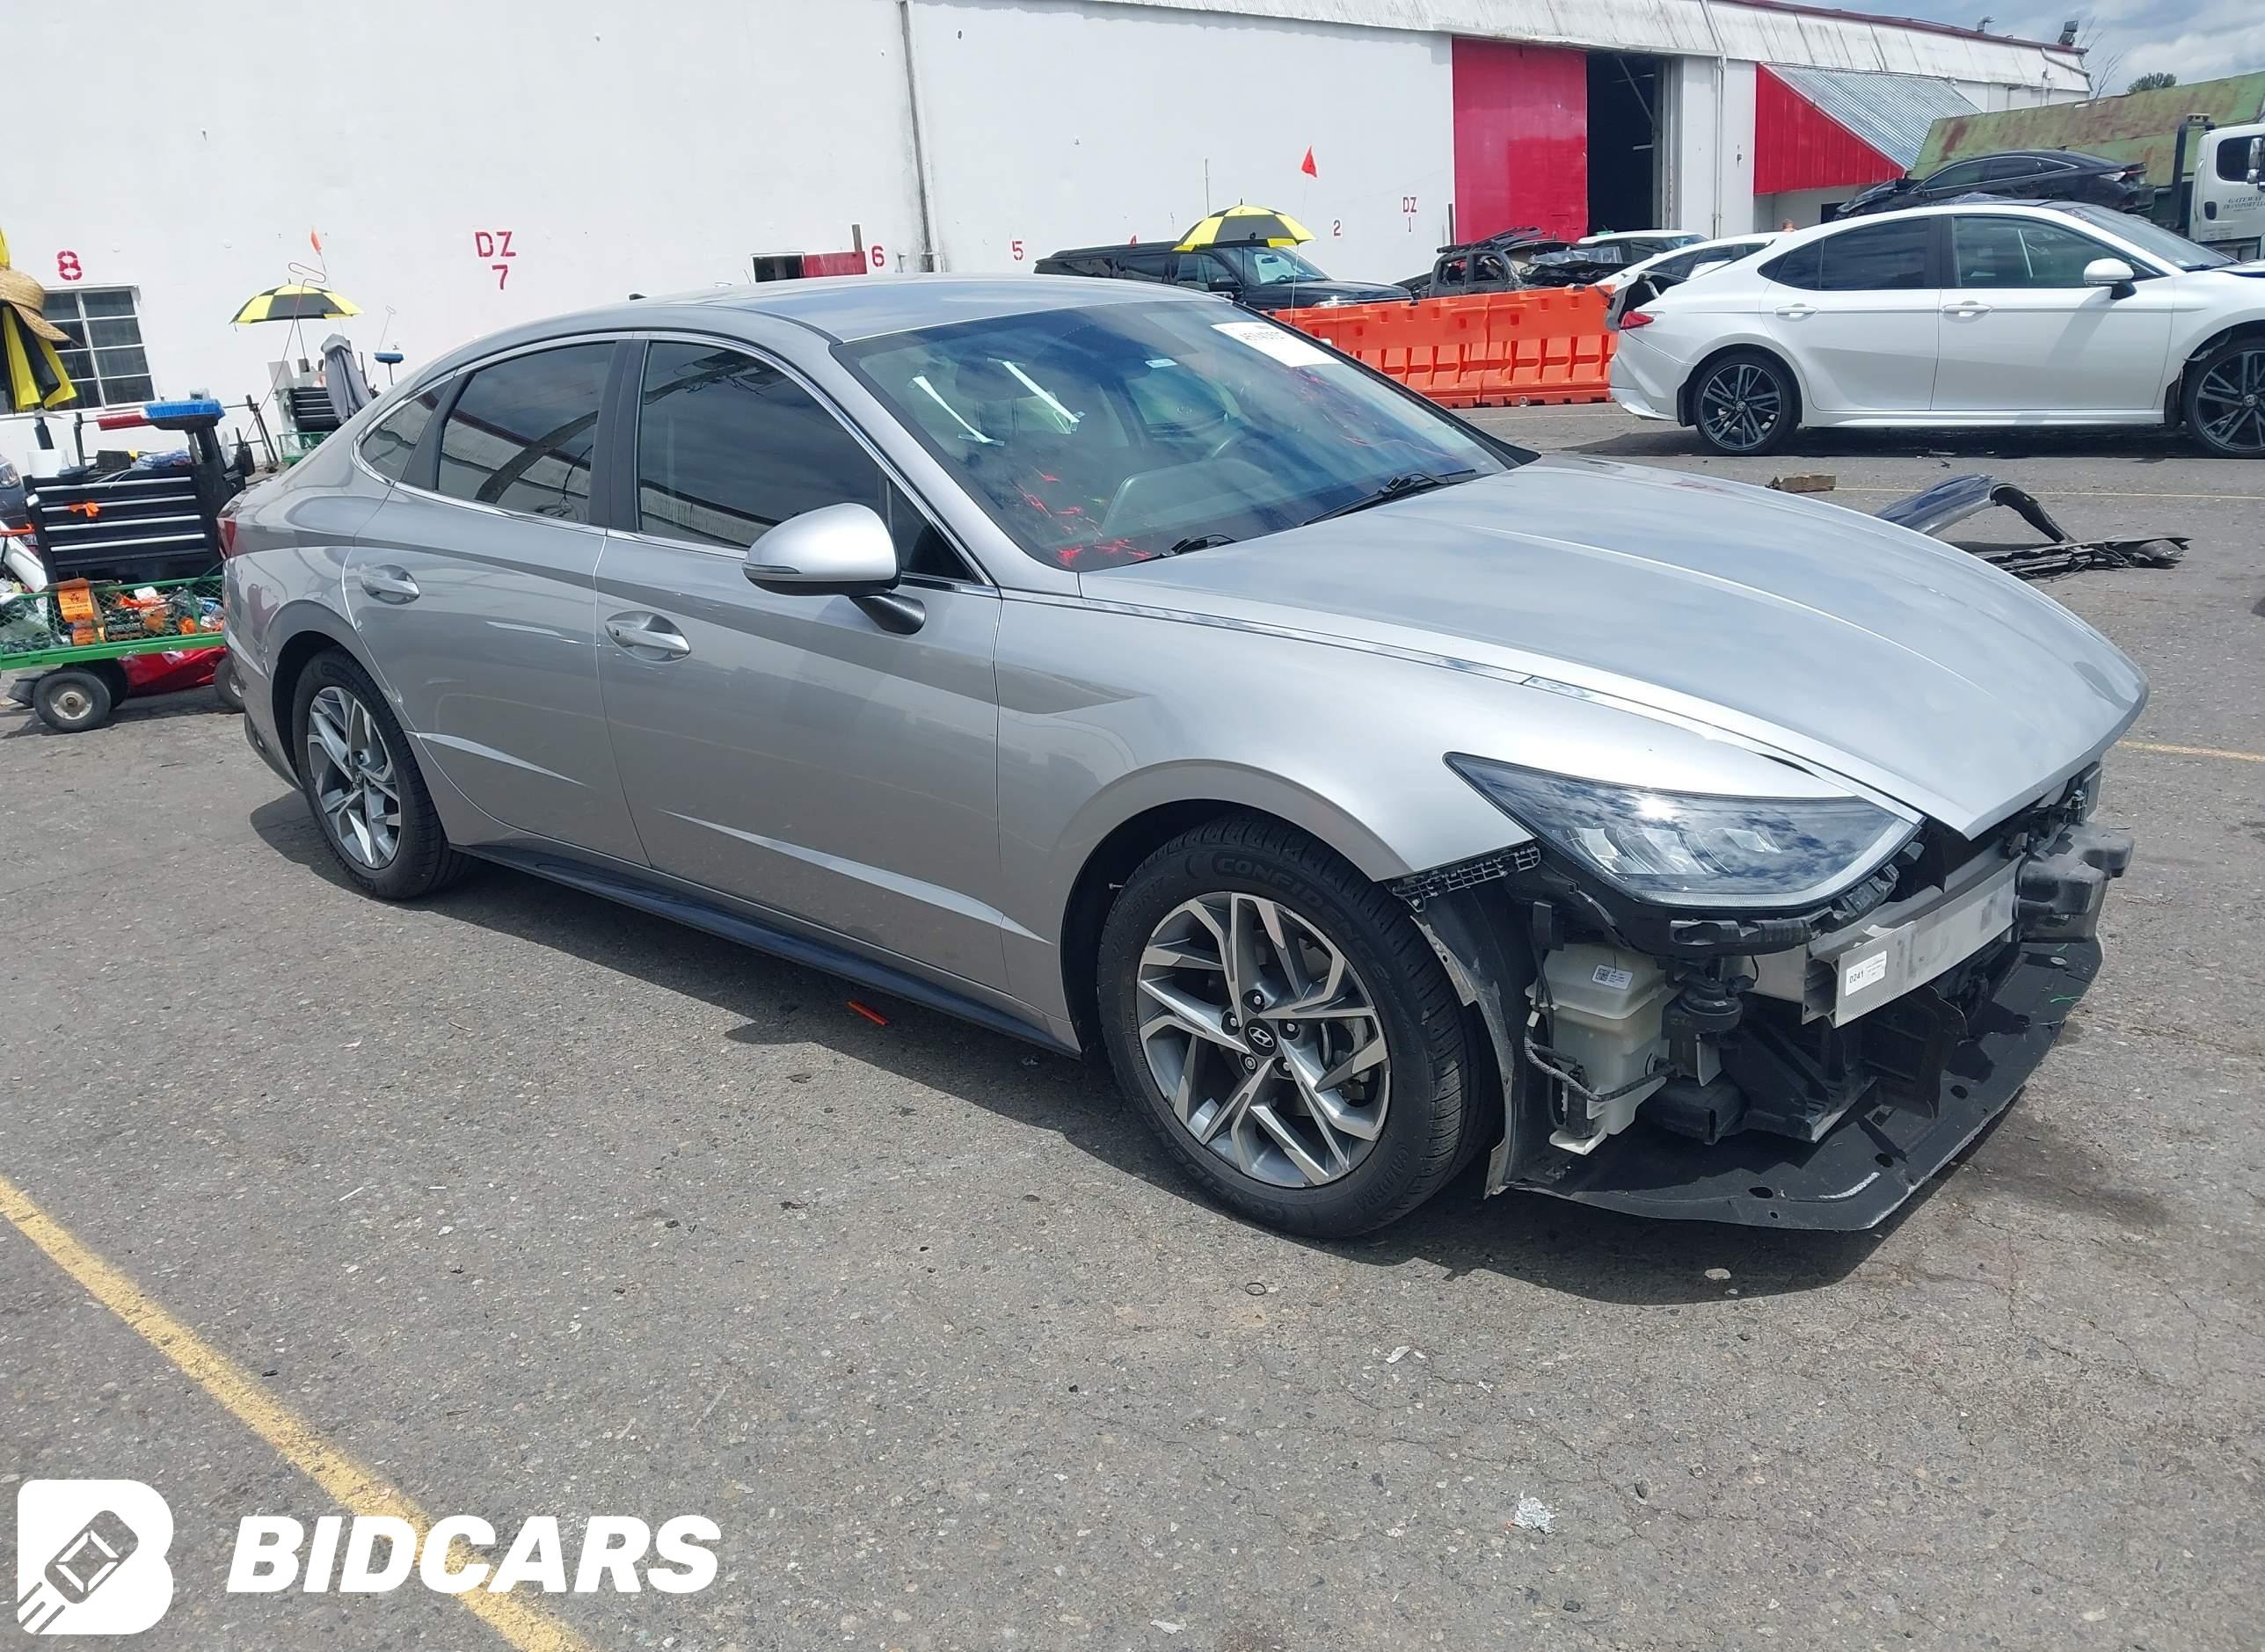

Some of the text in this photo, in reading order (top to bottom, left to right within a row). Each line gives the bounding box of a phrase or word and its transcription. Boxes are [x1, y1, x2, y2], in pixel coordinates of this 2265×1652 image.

[1402, 196, 1417, 213] DZ
[1333, 219, 1342, 237] 2
[475, 230, 517, 258] DZ
[1011, 240, 1024, 261] 5
[56, 250, 83, 281] 8
[871, 245, 885, 268] 6
[492, 264, 508, 290] 7
[1217, 857, 1392, 983] CONFIDENCE
[1849, 970, 1864, 984] 0241
